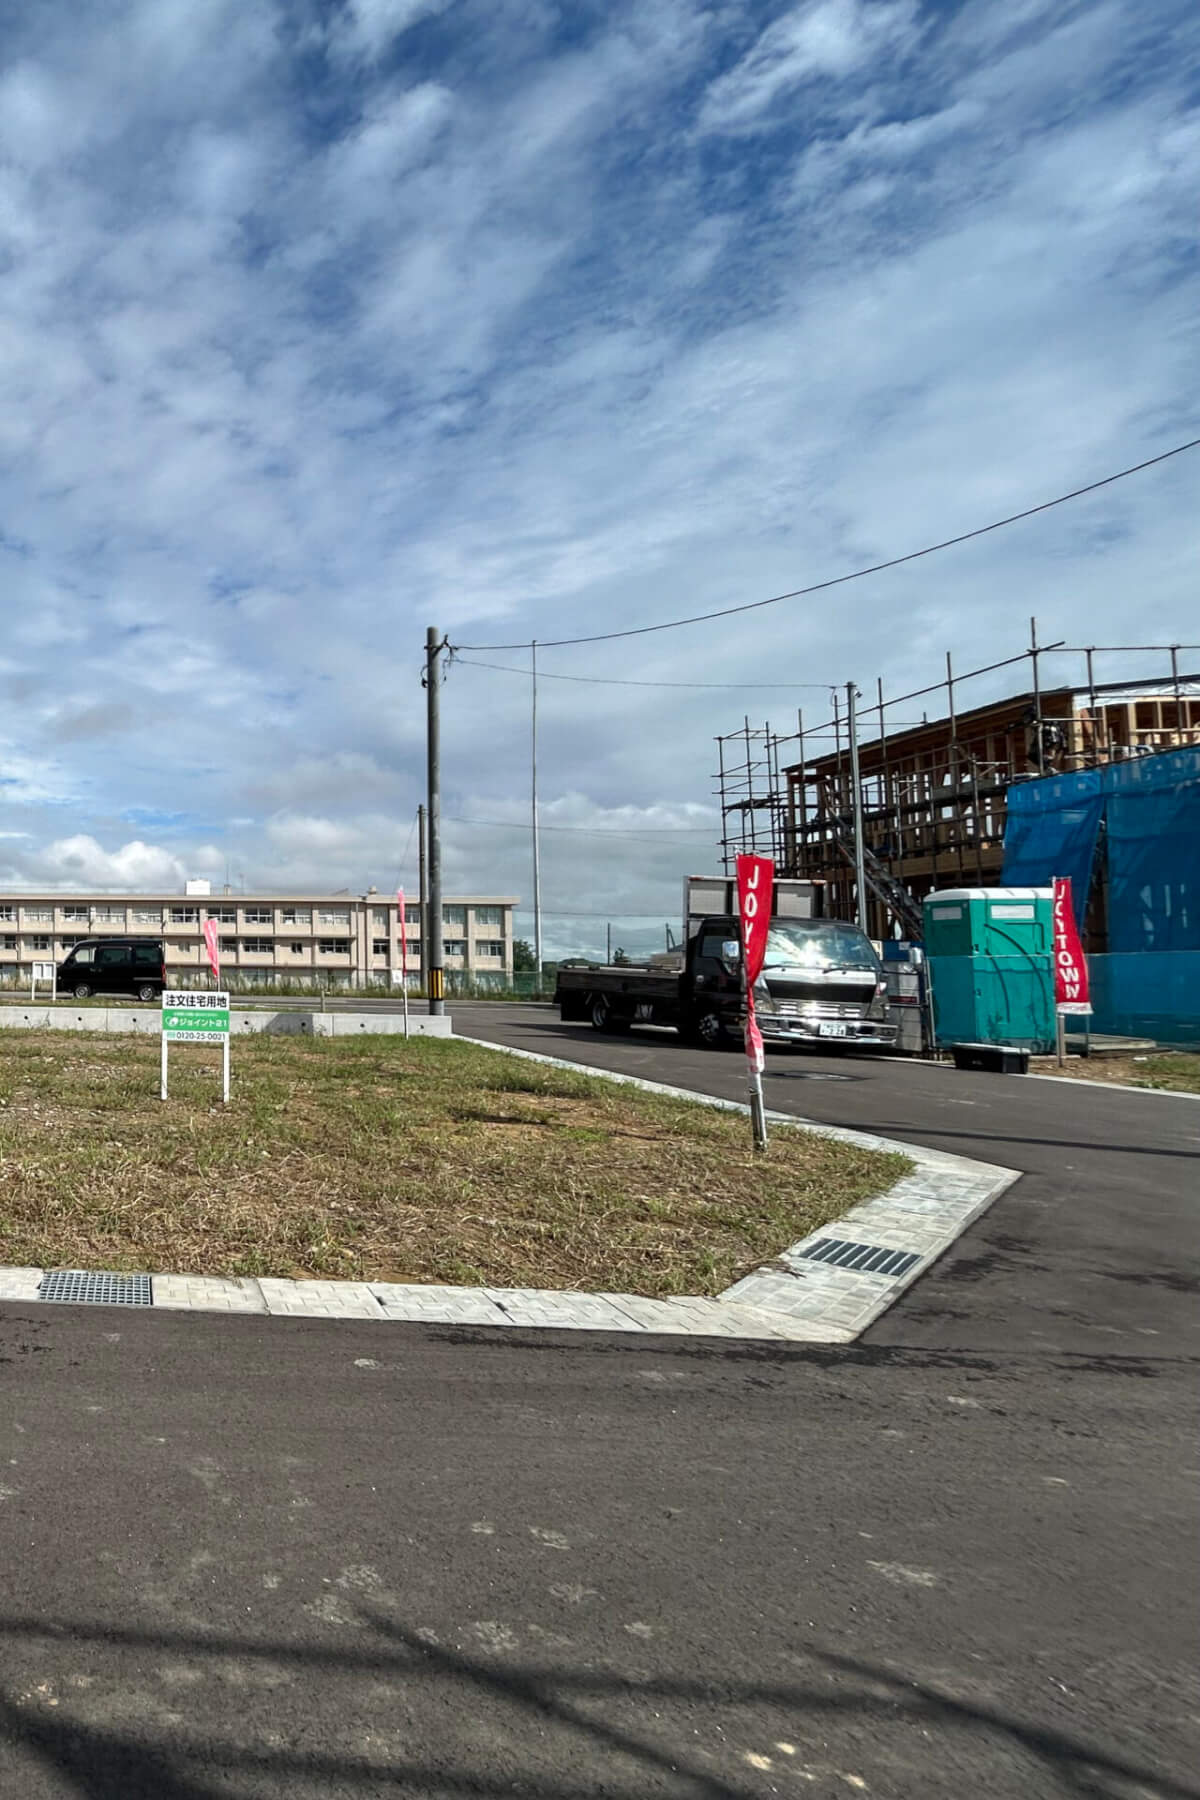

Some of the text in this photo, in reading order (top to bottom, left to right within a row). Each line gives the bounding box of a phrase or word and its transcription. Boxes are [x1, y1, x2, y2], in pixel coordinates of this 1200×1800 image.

[743, 864, 760, 955] JOY
[1055, 885, 1080, 999] JOYTOWN
[166, 994, 227, 1008] 注文住宅用地
[176, 1032, 225, 1040] 0120-25-0021
